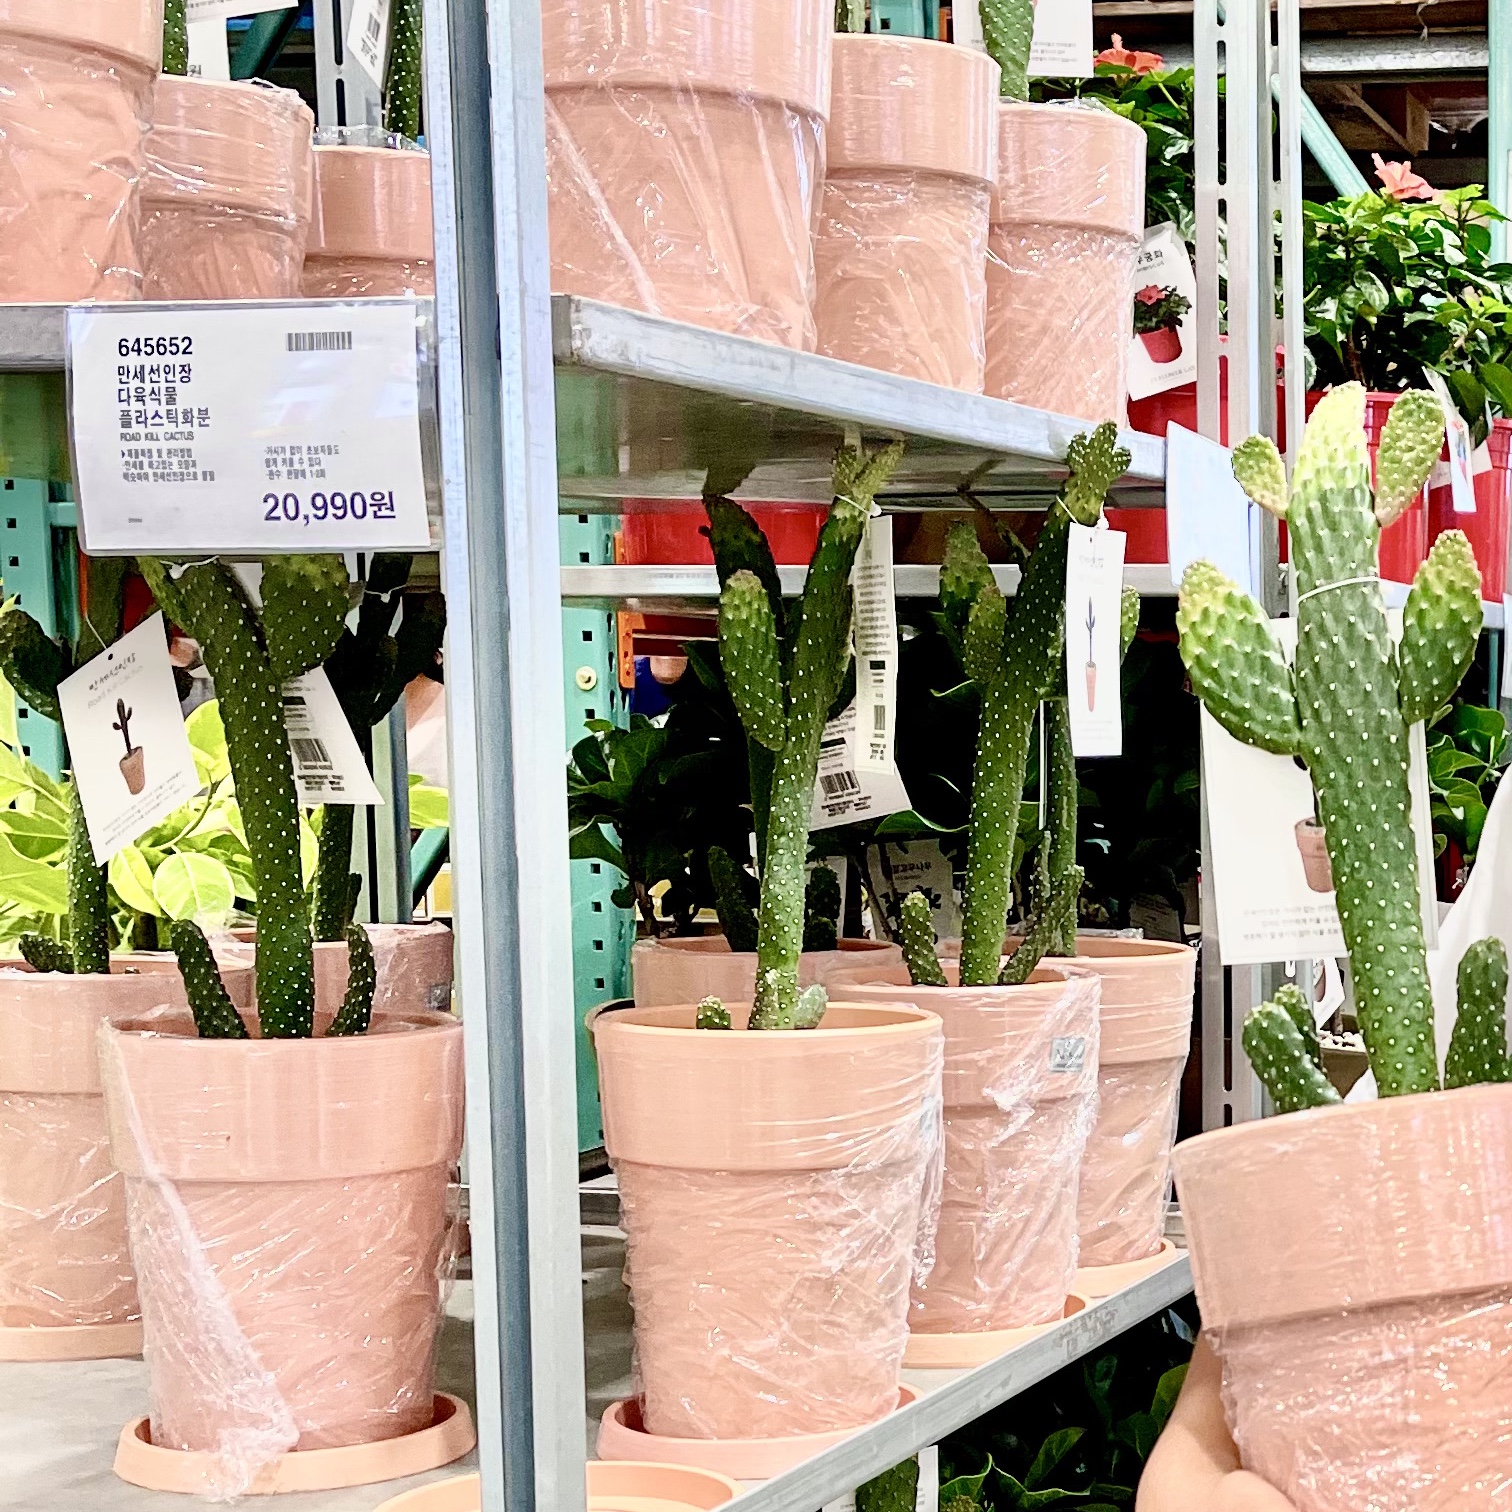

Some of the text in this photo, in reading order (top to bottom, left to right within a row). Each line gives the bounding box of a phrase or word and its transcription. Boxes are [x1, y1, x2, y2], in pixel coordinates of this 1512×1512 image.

[118, 336, 193, 357] 645652
[117, 363, 192, 385] 만세선인장
[117, 386, 178, 407] 다육식물
[118, 407, 211, 428] 플라스틱화분
[120, 431, 194, 441] ROAD KILL CACTUS
[263, 490, 396, 526] 20,990원
